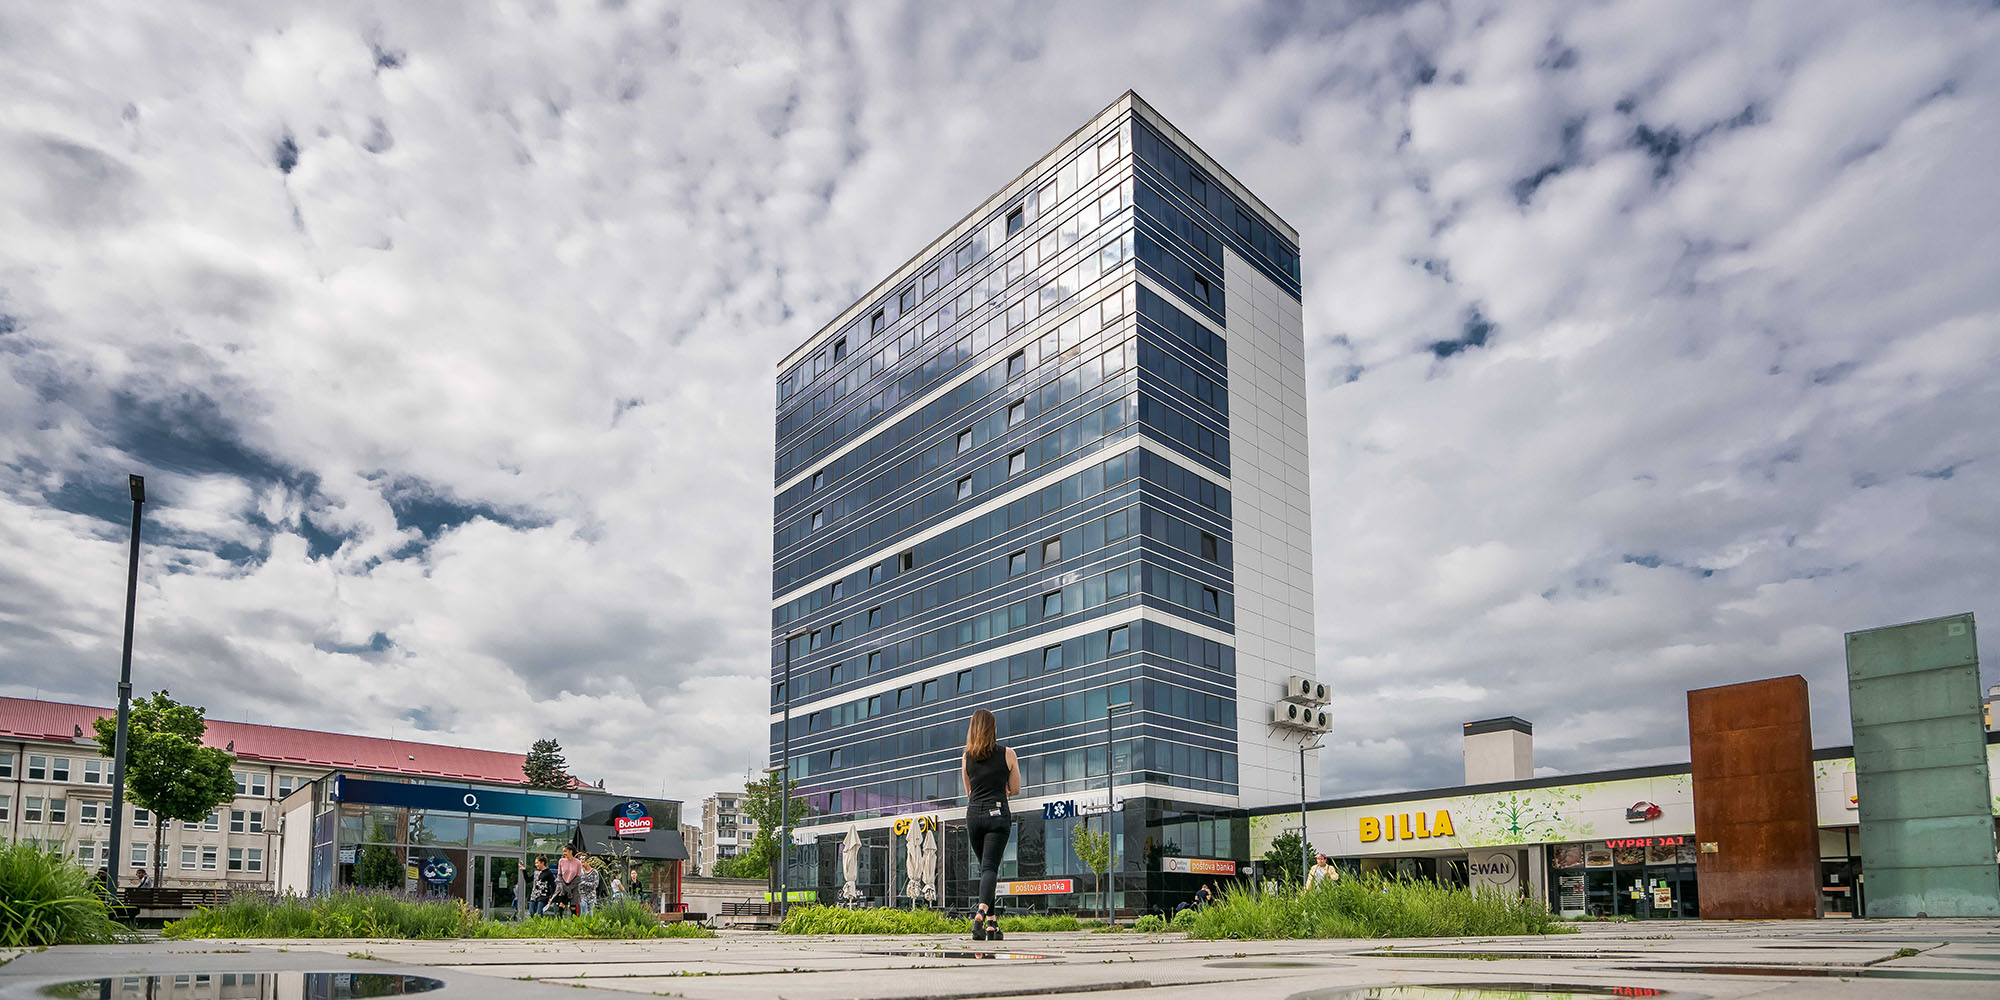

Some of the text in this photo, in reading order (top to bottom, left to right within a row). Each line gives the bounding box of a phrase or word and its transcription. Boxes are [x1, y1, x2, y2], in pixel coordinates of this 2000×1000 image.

[1042, 800, 1074, 820] ZION
[618, 819, 651, 829] Bublina
[1359, 809, 1455, 843] BILLA
[1216, 861, 1234, 873] banka
[1470, 863, 1509, 876] SWAN
[1015, 882, 1042, 894] poštová
[1043, 881, 1065, 891] banka
